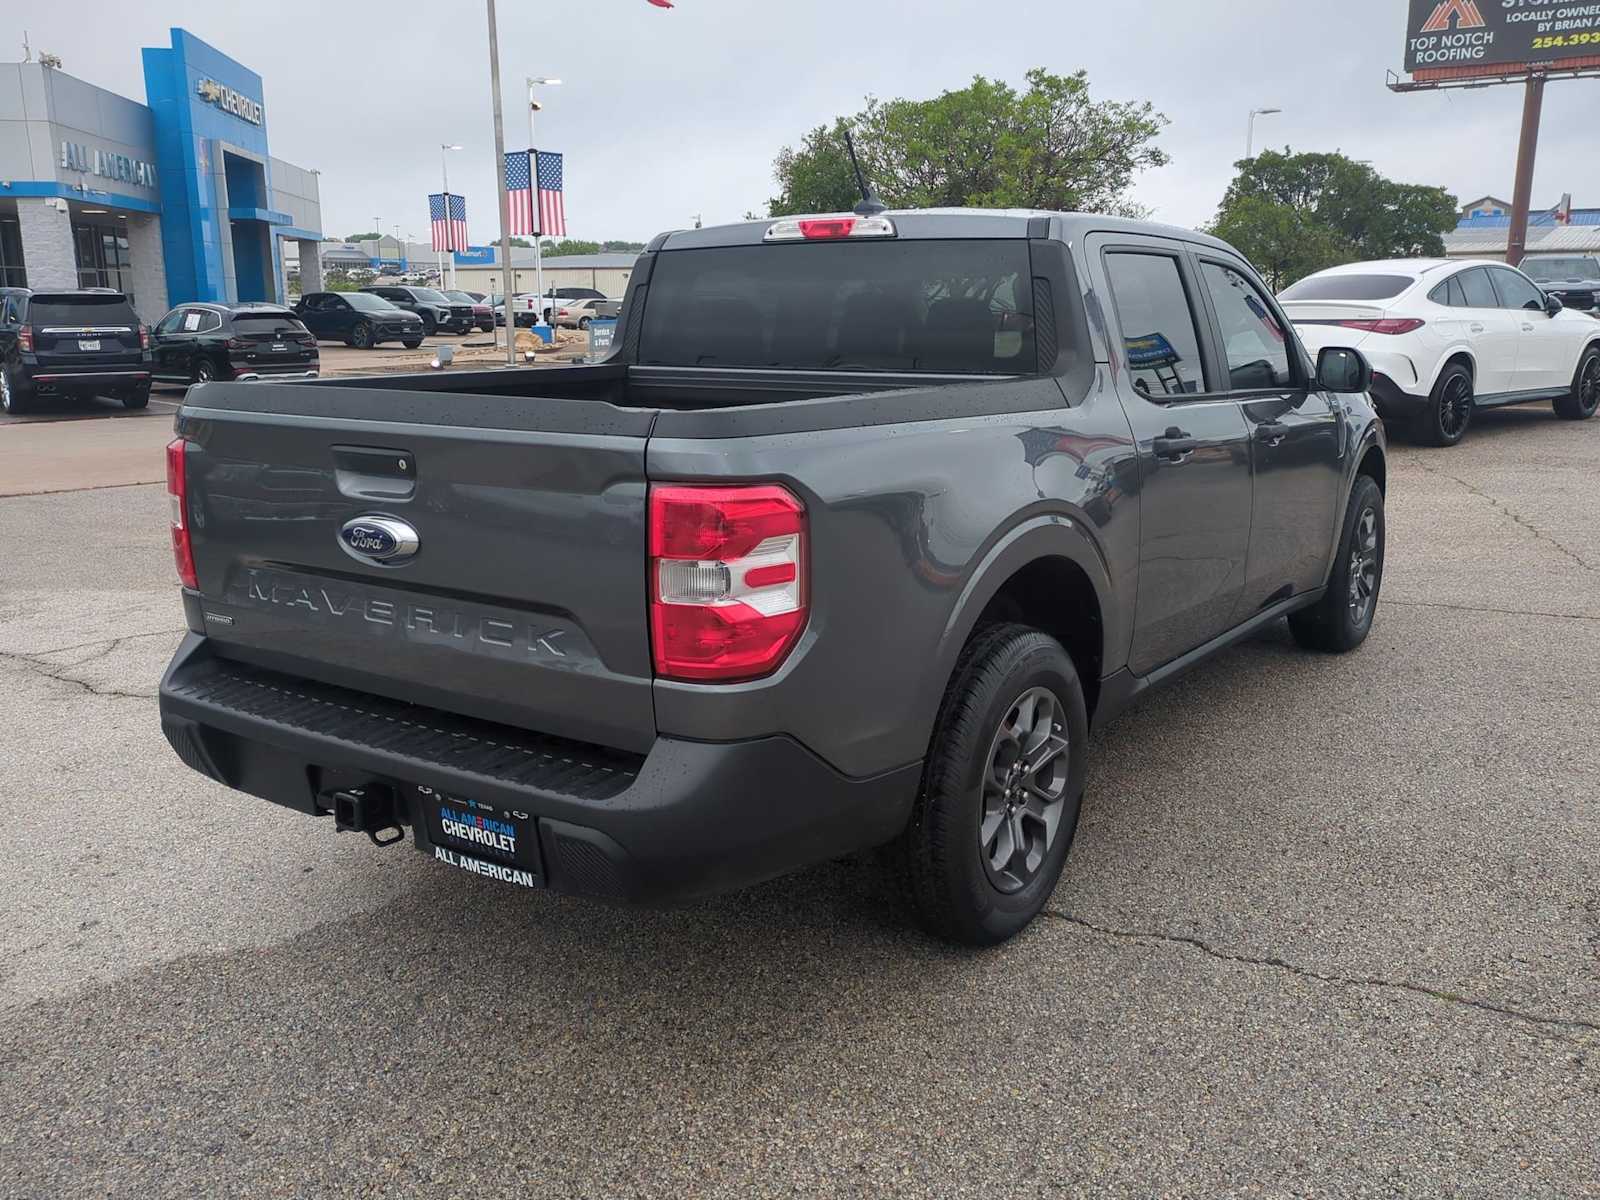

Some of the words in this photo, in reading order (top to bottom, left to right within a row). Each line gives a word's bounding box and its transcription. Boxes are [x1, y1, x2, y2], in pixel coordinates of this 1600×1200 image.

[1506, 10, 1555, 22] LOCALLY
[1537, 22, 1553, 32] BY
[1554, 17, 1592, 30] BRIAN
[1410, 37, 1437, 50] TOP
[1441, 32, 1494, 47] NOTCH
[1415, 46, 1485, 63] ROOFING
[220, 85, 262, 126] CHEVROLET
[61, 140, 91, 173] ALL
[94, 150, 159, 189] AMERICAN
[350, 526, 384, 550] Ford
[248, 572, 566, 656] MAVERICK
[441, 807, 459, 821] ALL
[461, 812, 515, 837] AMERICAN
[441, 818, 516, 853] CHEVROLET
[435, 846, 458, 866] ALL
[460, 855, 534, 888] AMERICAN
